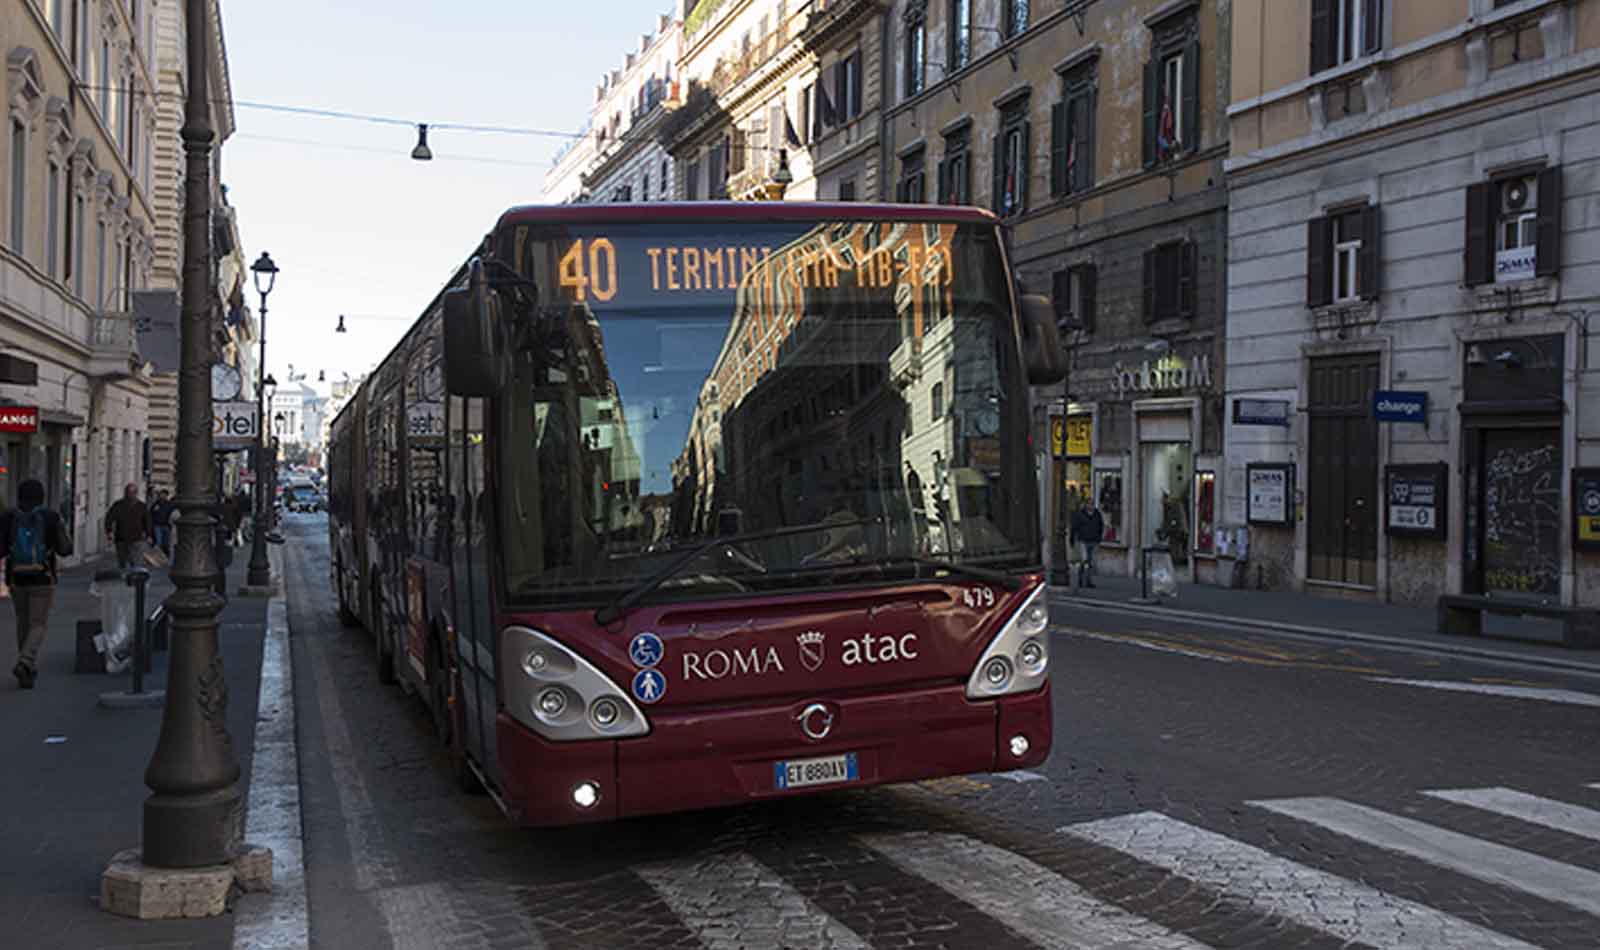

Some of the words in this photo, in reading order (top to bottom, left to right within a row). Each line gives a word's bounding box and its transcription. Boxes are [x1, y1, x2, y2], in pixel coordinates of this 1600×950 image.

[559, 237, 617, 302] 40
[645, 247, 772, 290] TERMINI
[1376, 400, 1422, 415] change
[0, 415, 36, 426] ANGE
[212, 412, 255, 434] otel
[962, 586, 995, 609] 479
[682, 645, 784, 681] ROMA
[840, 632, 919, 667] atac
